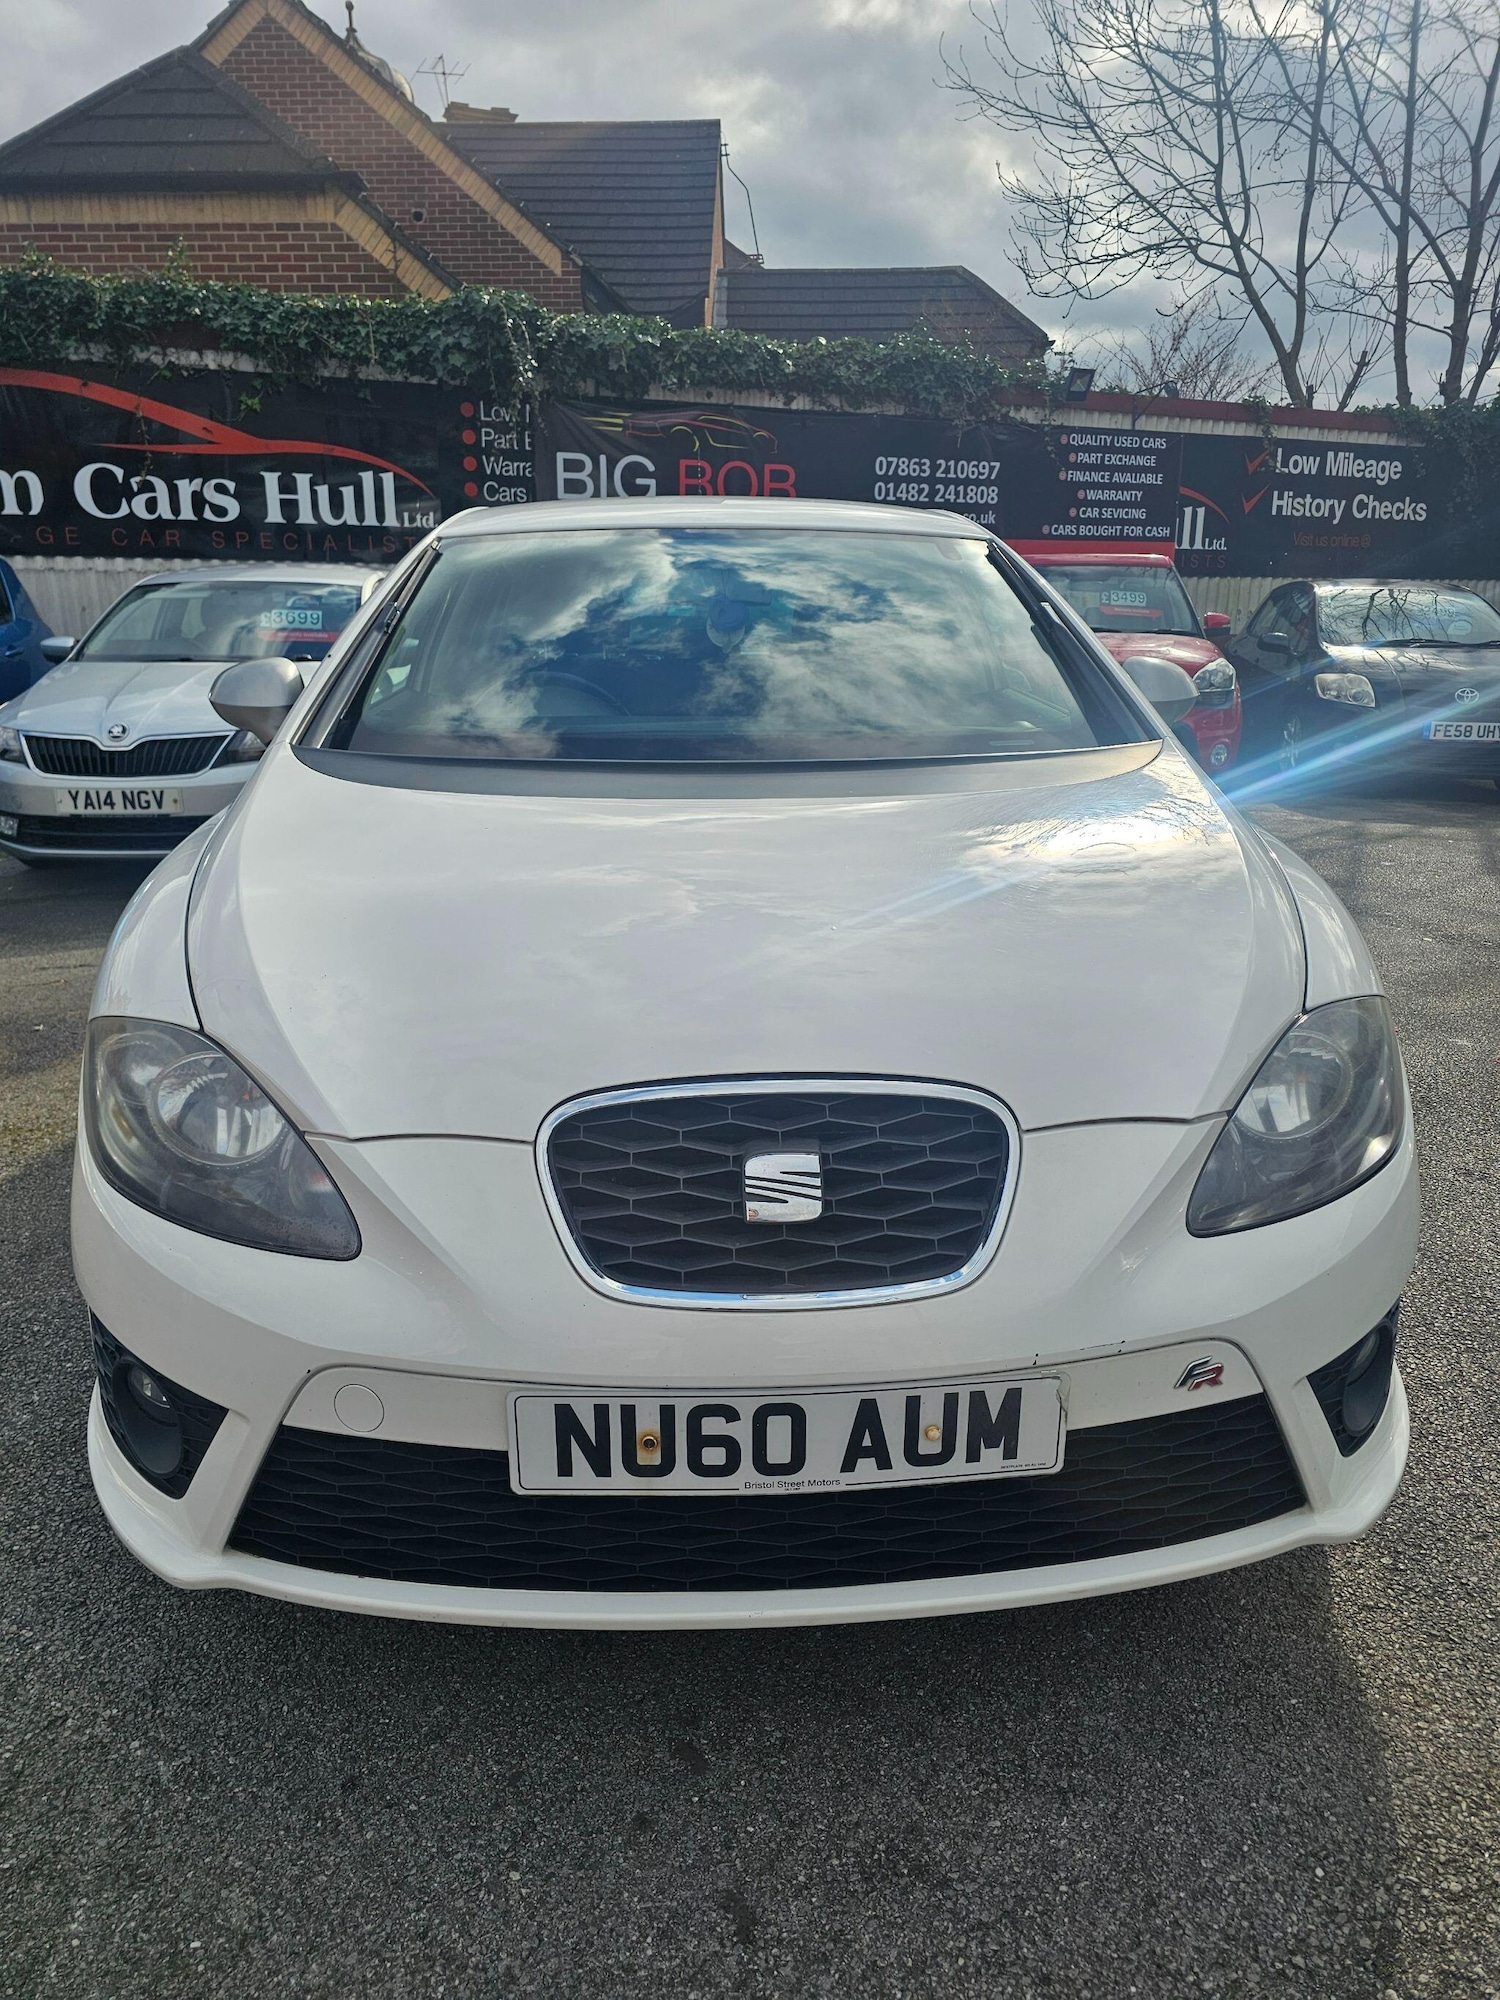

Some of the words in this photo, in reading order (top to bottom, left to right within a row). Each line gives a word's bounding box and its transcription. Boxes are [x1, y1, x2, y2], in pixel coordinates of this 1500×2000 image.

[1069, 434, 1112, 446] QUALITY
[1114, 436, 1140, 448] USED
[1142, 438, 1167, 449] CARS
[875, 456, 931, 477] 07863
[936, 459, 1000, 480] 210697
[1077, 453, 1103, 464] PART
[1104, 454, 1156, 466] EXCHANGE
[1275, 448, 1320, 475] Low
[1325, 451, 1402, 486] Mileage
[556, 451, 656, 499] BIG
[679, 459, 797, 498] BOB
[1067, 471, 1110, 482] FINANCE
[1112, 472, 1163, 485] AVALIABLE
[73, 462, 241, 523] Cars
[259, 470, 401, 527] Hull
[483, 481, 527, 502] Cars
[874, 481, 929, 502] 01482
[934, 484, 998, 505] 241808
[1086, 489, 1143, 501] WARRANTY
[1079, 507, 1099, 518] CAR
[1101, 508, 1147, 519] SEVICING
[1271, 490, 1347, 525] History
[1352, 493, 1428, 522] Checks
[111, 528, 181, 547] CAR
[1051, 524, 1077, 536] CARS
[1079, 525, 1122, 536] BOUGHT
[1123, 526, 1143, 537] FOR
[1145, 526, 1170, 537] CASH
[1204, 537, 1227, 551] Ltd.
[1101, 591, 1145, 604] £3499
[260, 611, 320, 625] £3699
[1433, 724, 1473, 738] FE58
[68, 790, 116, 810] YA14
[121, 790, 164, 810] NGV
[1174, 1355, 1223, 1391] FR
[553, 1402, 807, 1478] NU60
[839, 1387, 1022, 1473] AUM
[744, 1481, 774, 1489] Bristol
[777, 1480, 805, 1488] Street
[807, 1479, 840, 1487] Motors
